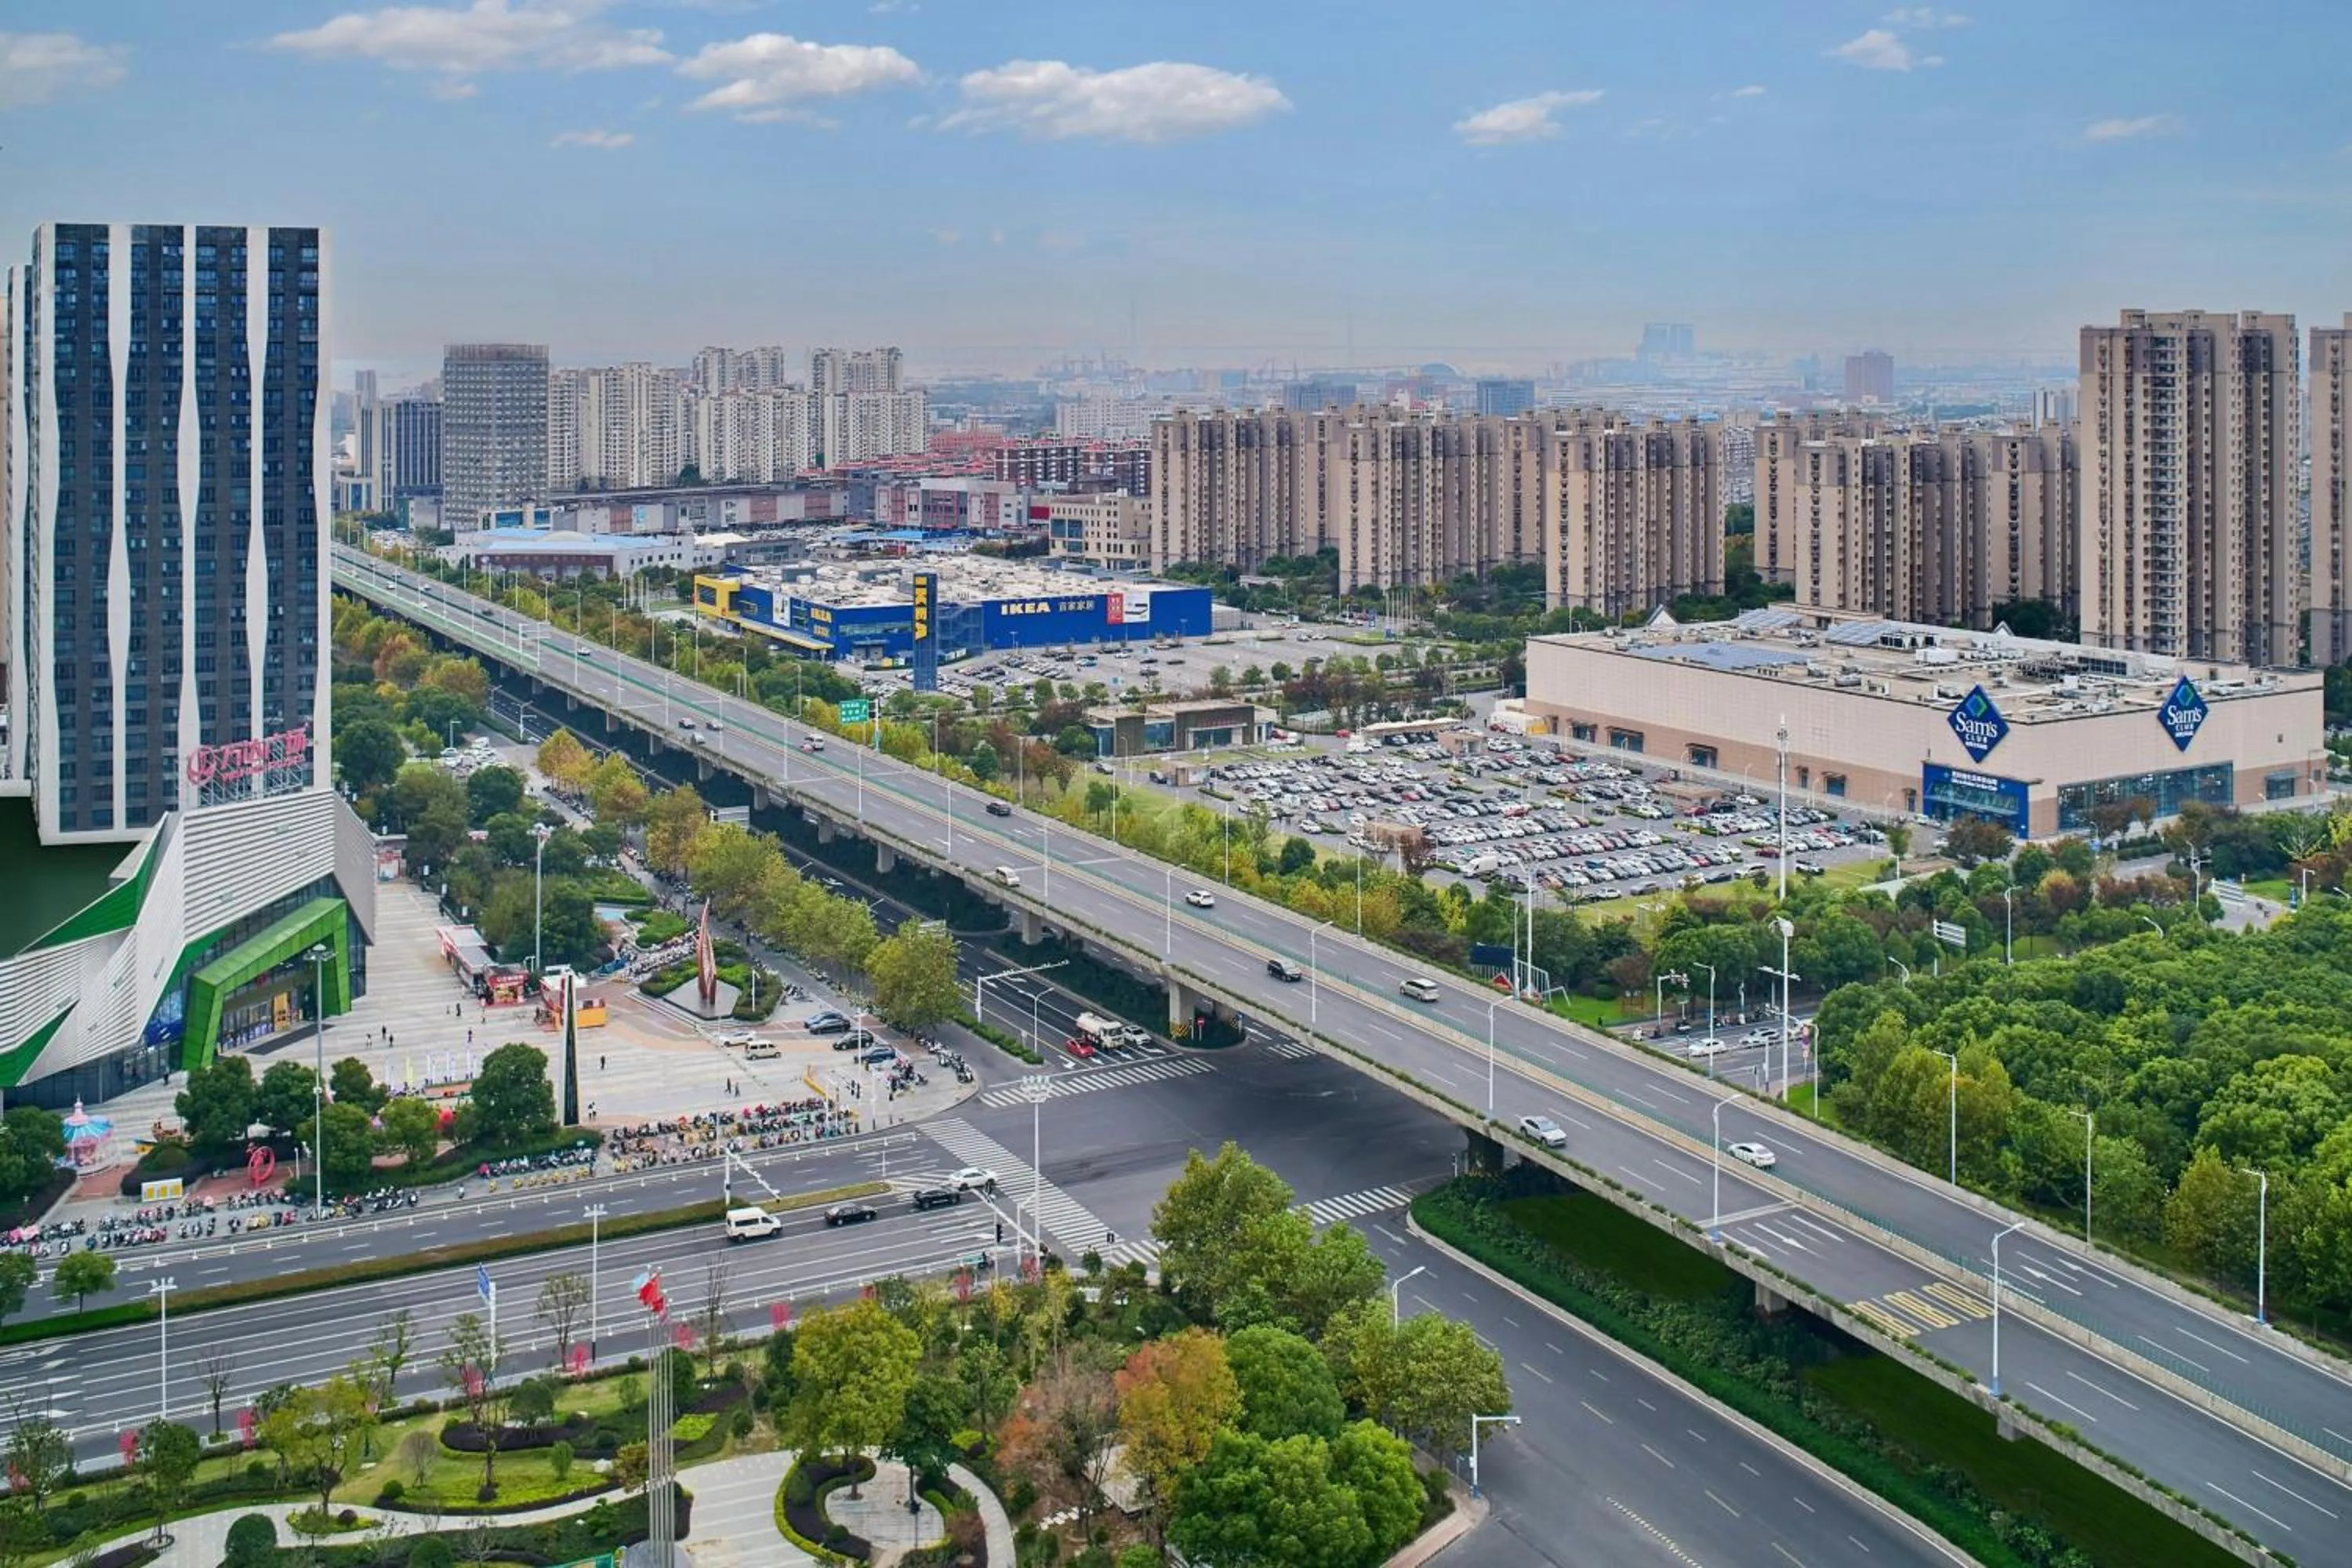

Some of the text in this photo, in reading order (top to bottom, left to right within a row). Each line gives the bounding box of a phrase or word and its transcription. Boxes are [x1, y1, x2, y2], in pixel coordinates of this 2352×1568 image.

[915, 576, 927, 640] IKEA
[1001, 602, 1051, 615] IKEA
[1956, 711, 1998, 738] Sam's
[2167, 705, 2202, 725] Sam's
